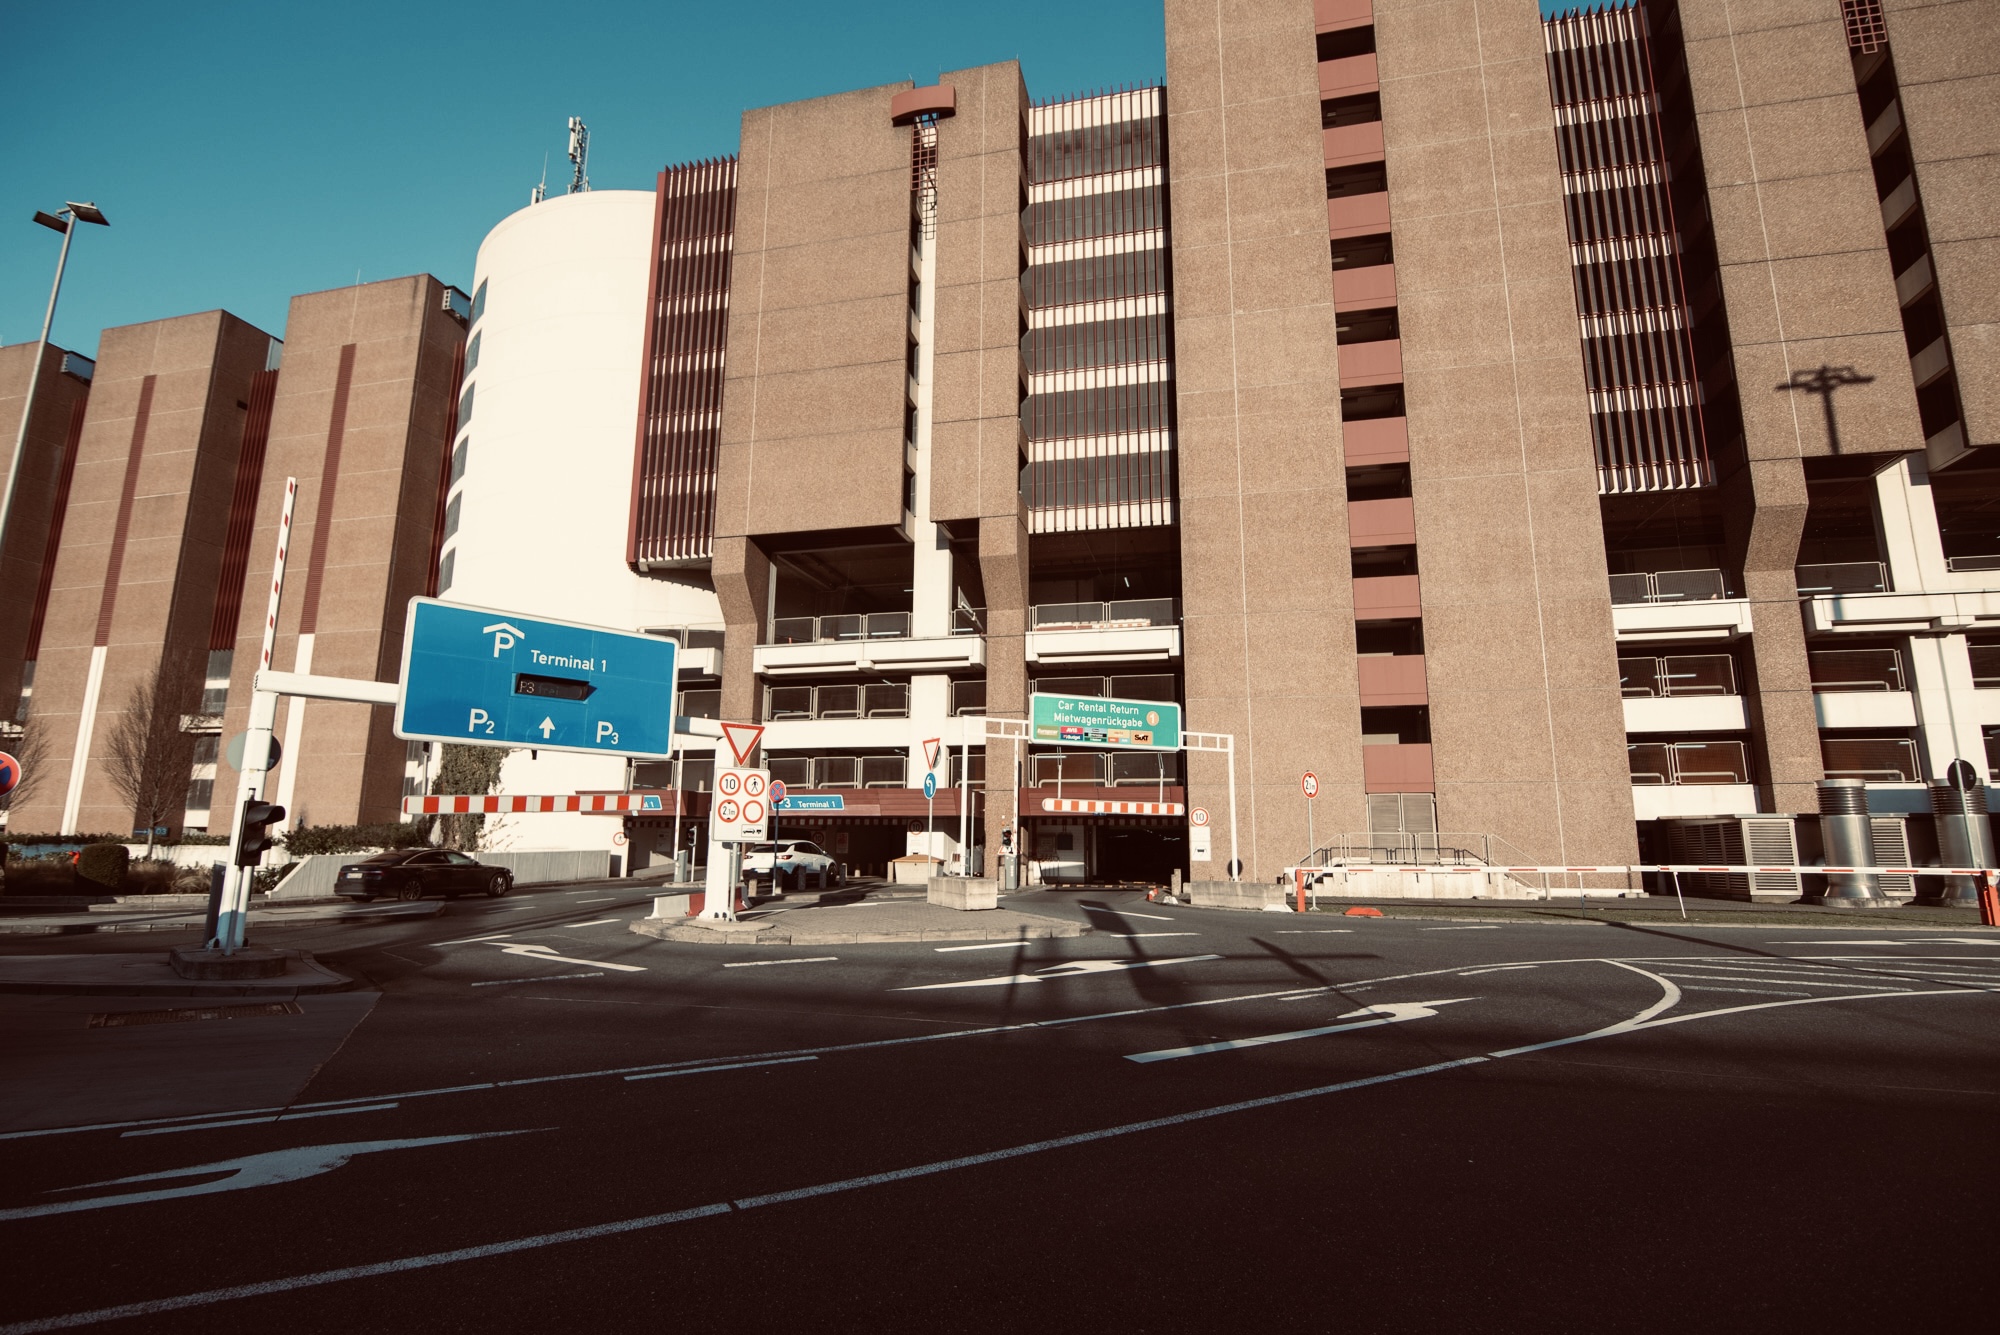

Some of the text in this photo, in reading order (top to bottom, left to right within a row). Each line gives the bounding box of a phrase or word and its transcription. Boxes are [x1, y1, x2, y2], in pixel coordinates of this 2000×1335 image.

[493, 632, 515, 658] P
[531, 649, 607, 673] Terminal 1
[519, 680, 535, 694] P3
[1058, 700, 1139, 715] Car Rental Return
[468, 708, 495, 734] P2
[1053, 712, 1143, 729] Mietwagenrückgabe
[1149, 713, 1156, 724] 1
[596, 720, 619, 745] P3
[725, 778, 736, 790] 10
[797, 800, 829, 808] Terminal
[832, 800, 836, 808] 1
[1195, 812, 1205, 822] 10
[911, 823, 921, 832] 10
